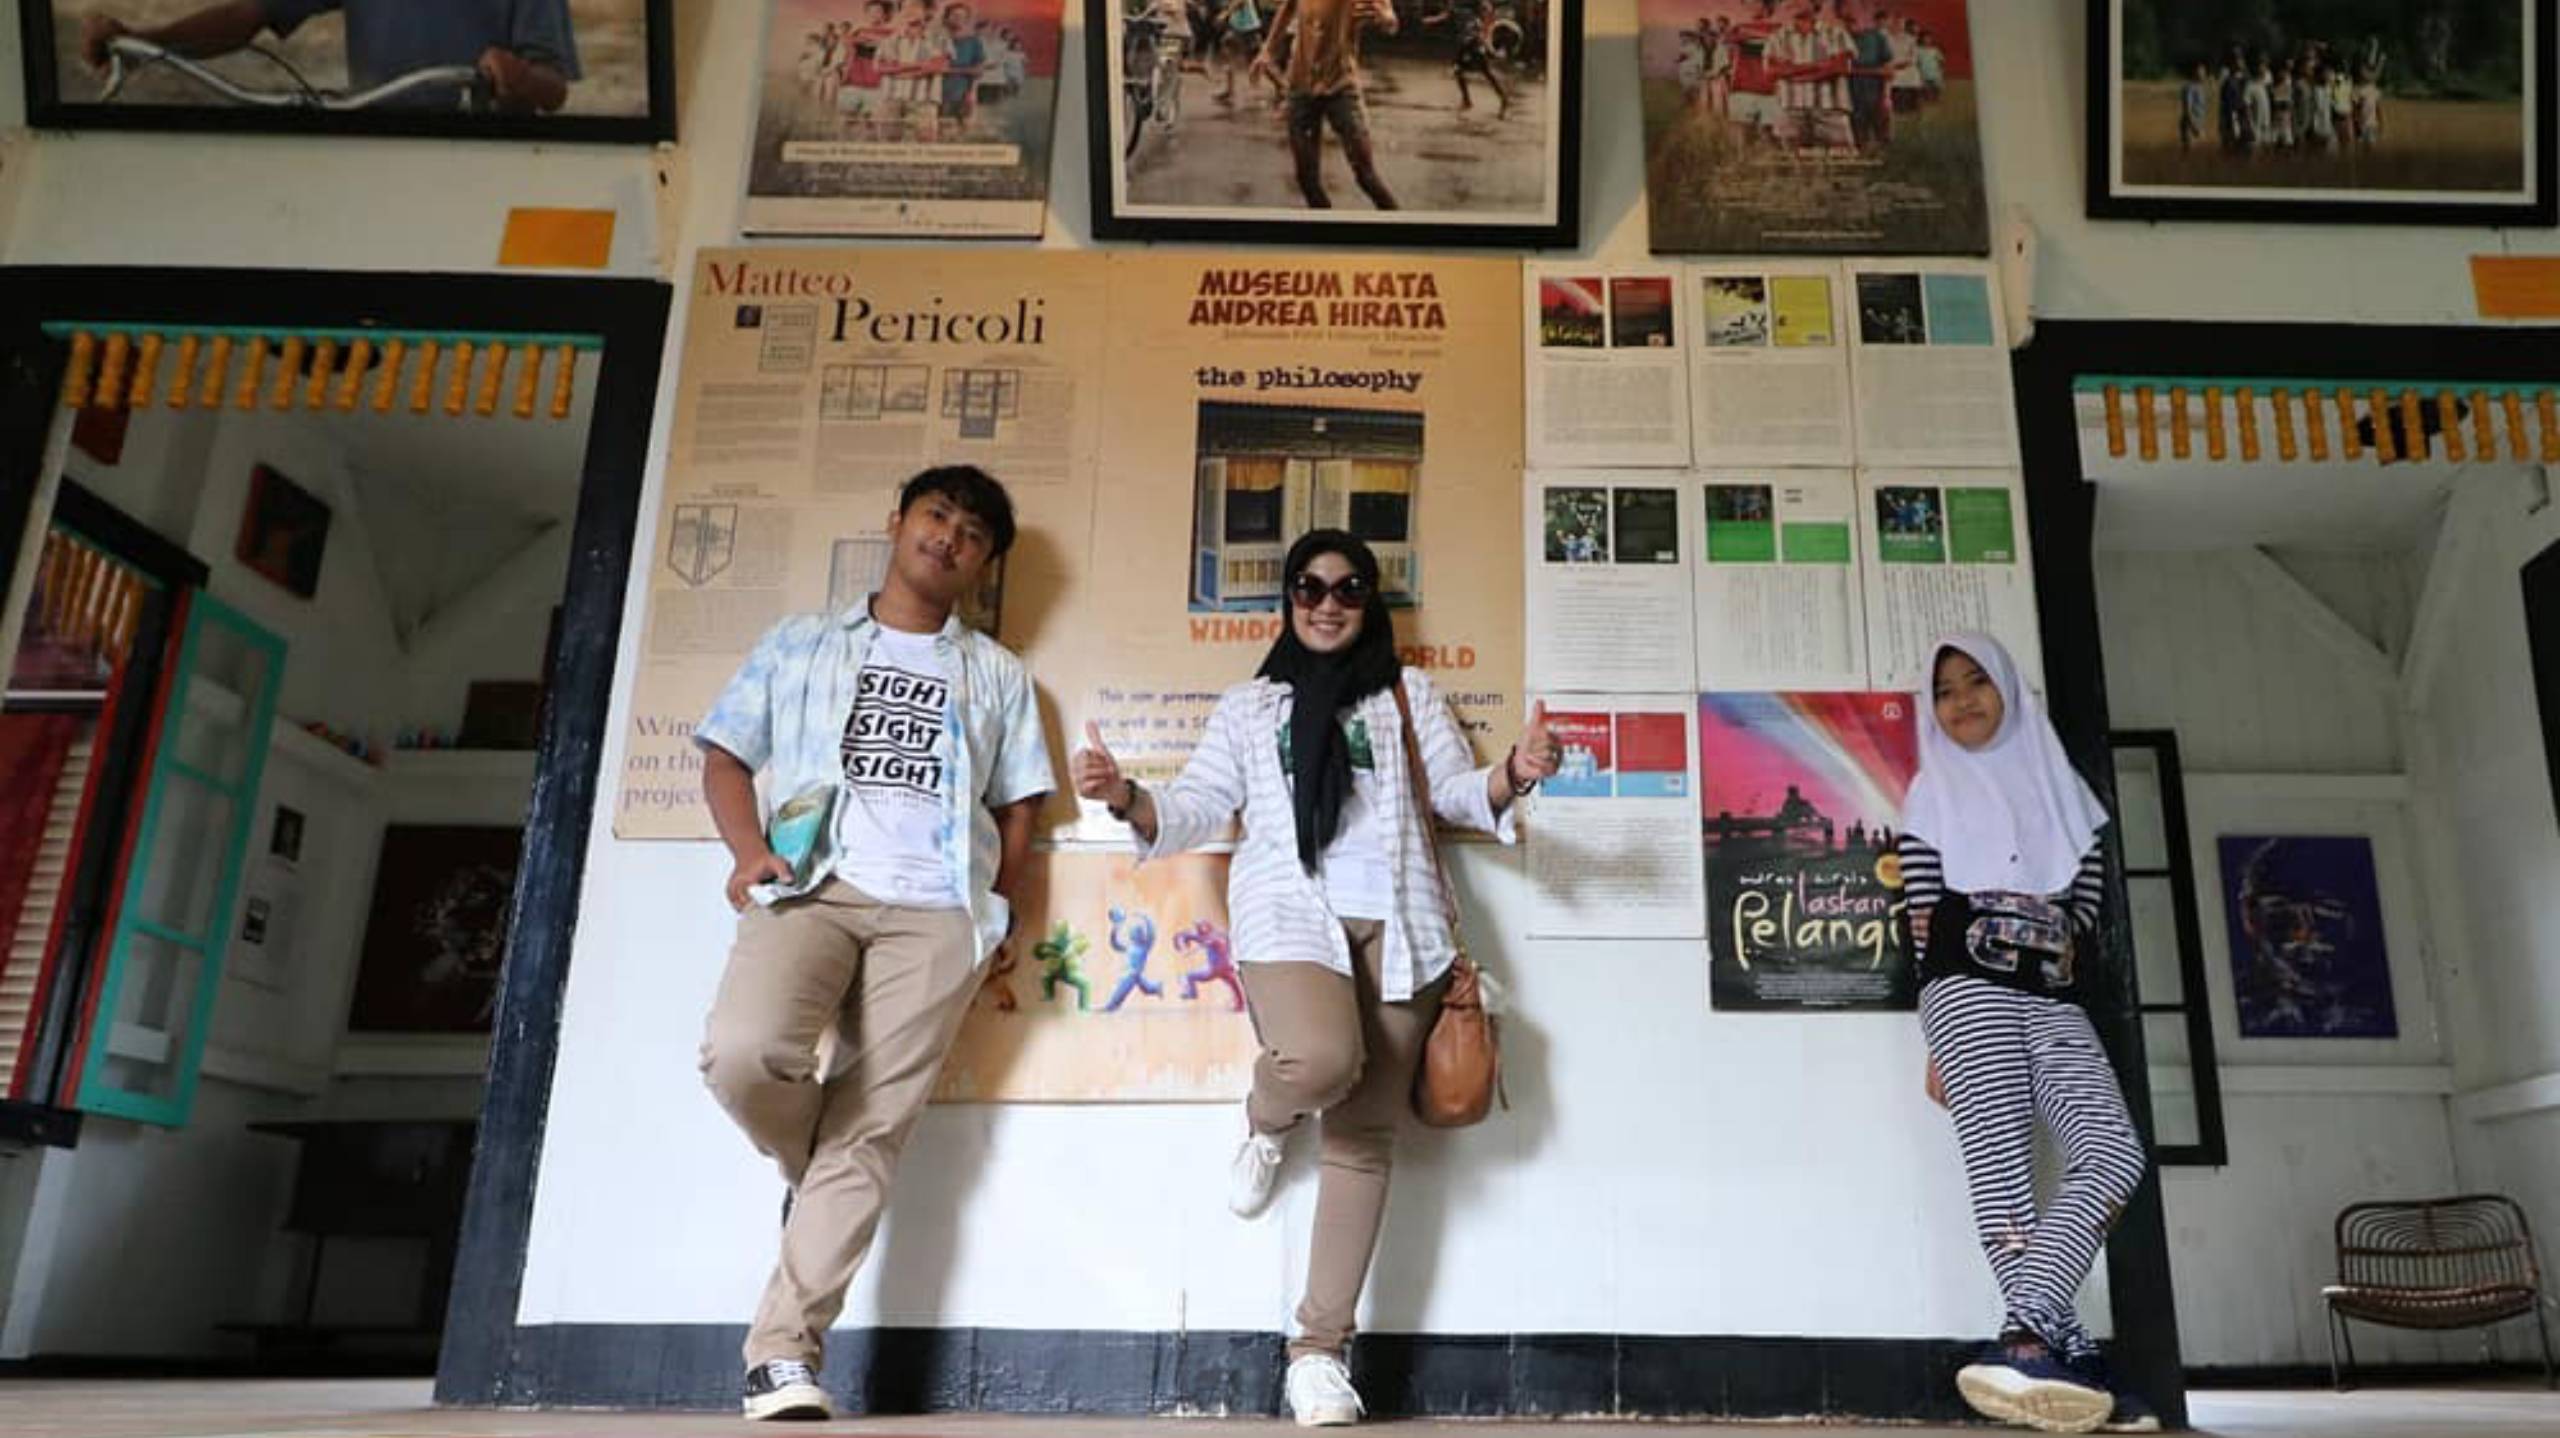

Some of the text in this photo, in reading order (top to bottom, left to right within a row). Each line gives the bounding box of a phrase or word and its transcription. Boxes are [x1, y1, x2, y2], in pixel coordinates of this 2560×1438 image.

[704, 262, 853, 297] Matteo
[1197, 270, 1439, 299] MUSEUM KATA
[830, 296, 1046, 344] Pericoli
[1188, 300, 1447, 329] ANDREA HIRATA
[1195, 366, 1423, 393] the philosophy
[1189, 617, 1282, 642] WINDO
[1400, 644, 1477, 670] ORLD
[858, 672, 948, 708] SIGHT
[1445, 690, 1504, 706] useum
[628, 754, 659, 771] on
[624, 784, 698, 812] projec
[1797, 869, 1886, 916] laskar
[1732, 889, 1908, 972] Pelangi
